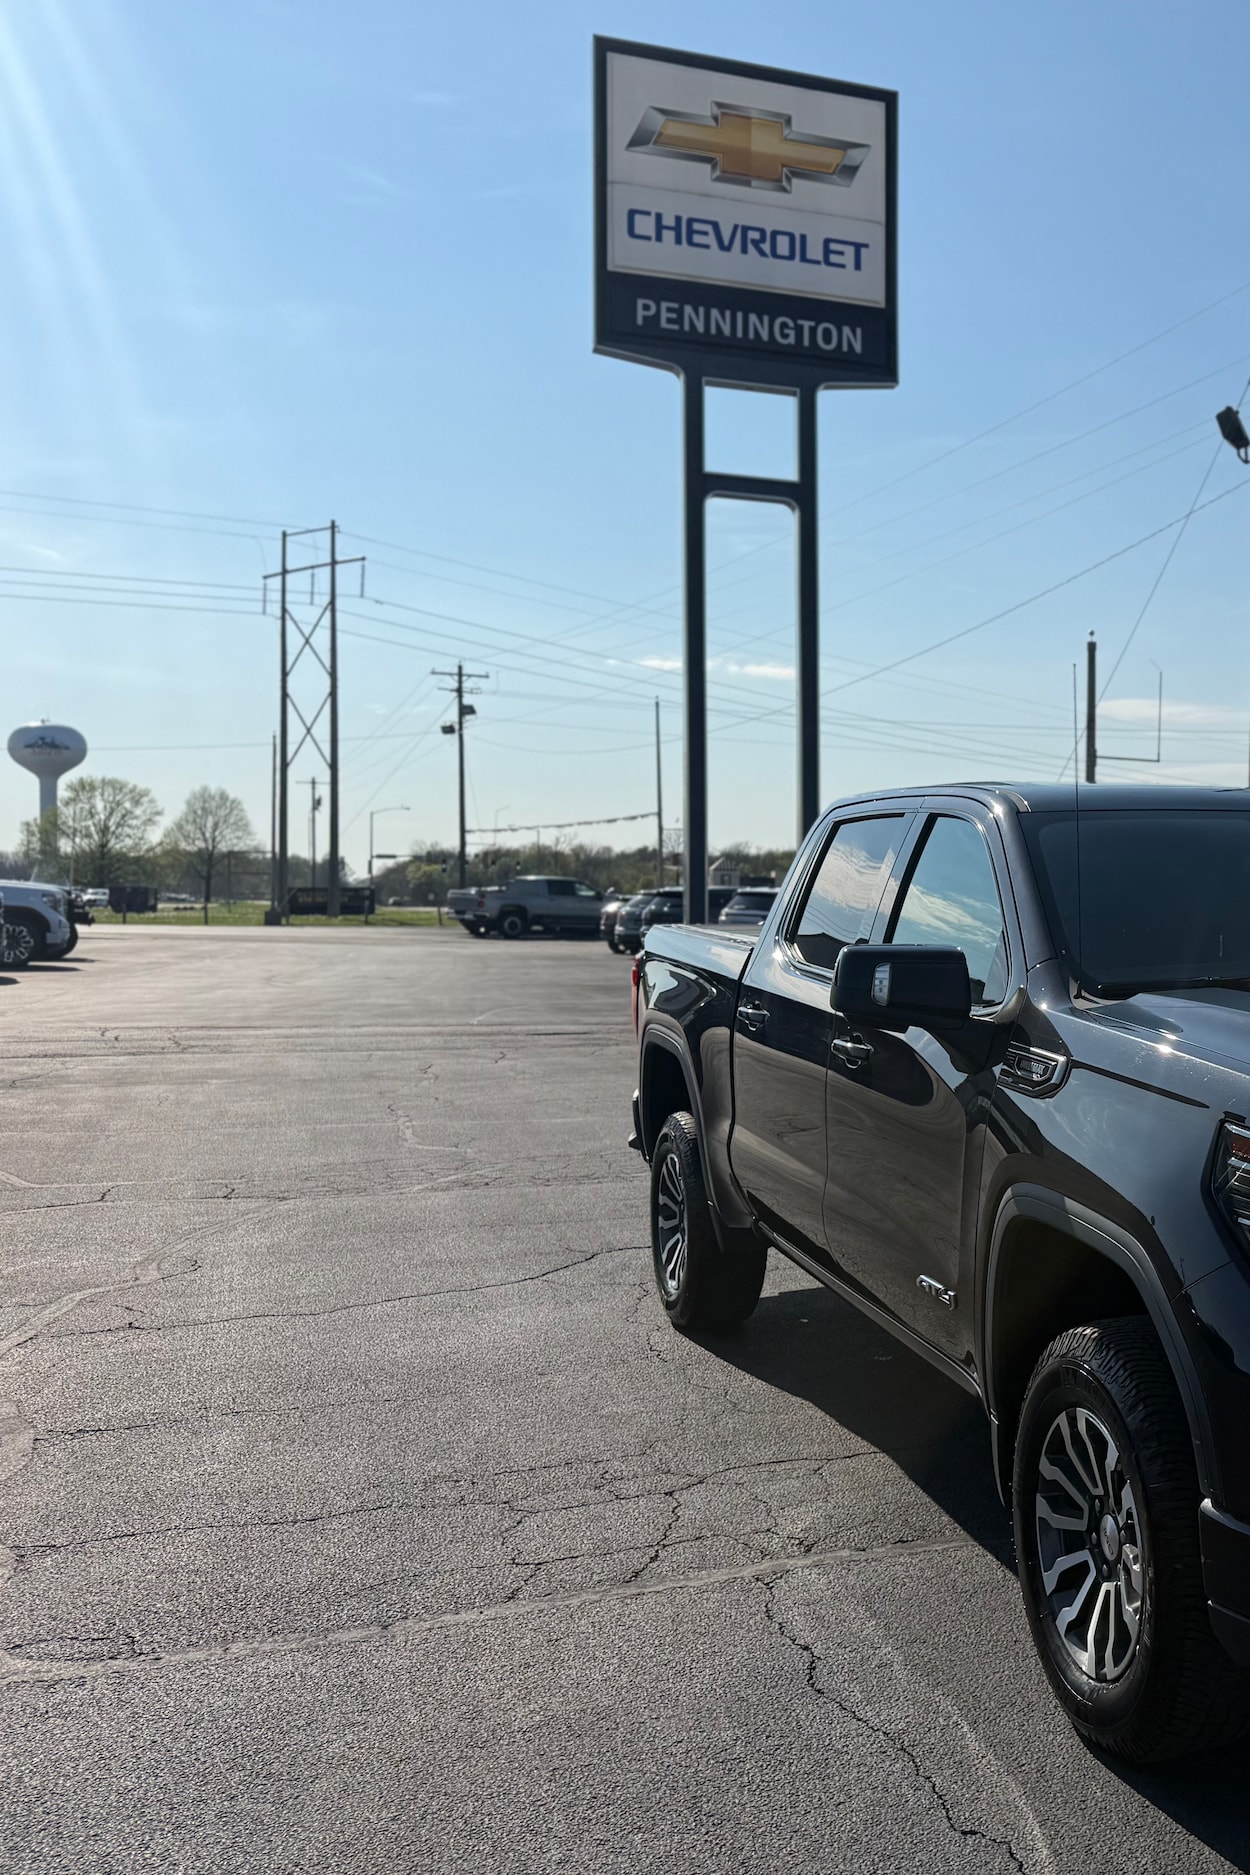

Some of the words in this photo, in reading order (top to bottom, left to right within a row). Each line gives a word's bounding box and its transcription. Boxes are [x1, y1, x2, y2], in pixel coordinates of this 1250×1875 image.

[627, 208, 870, 272] CHEVROLET
[636, 297, 863, 354] PENNINGTON
[915, 1274, 957, 1310] AT4
